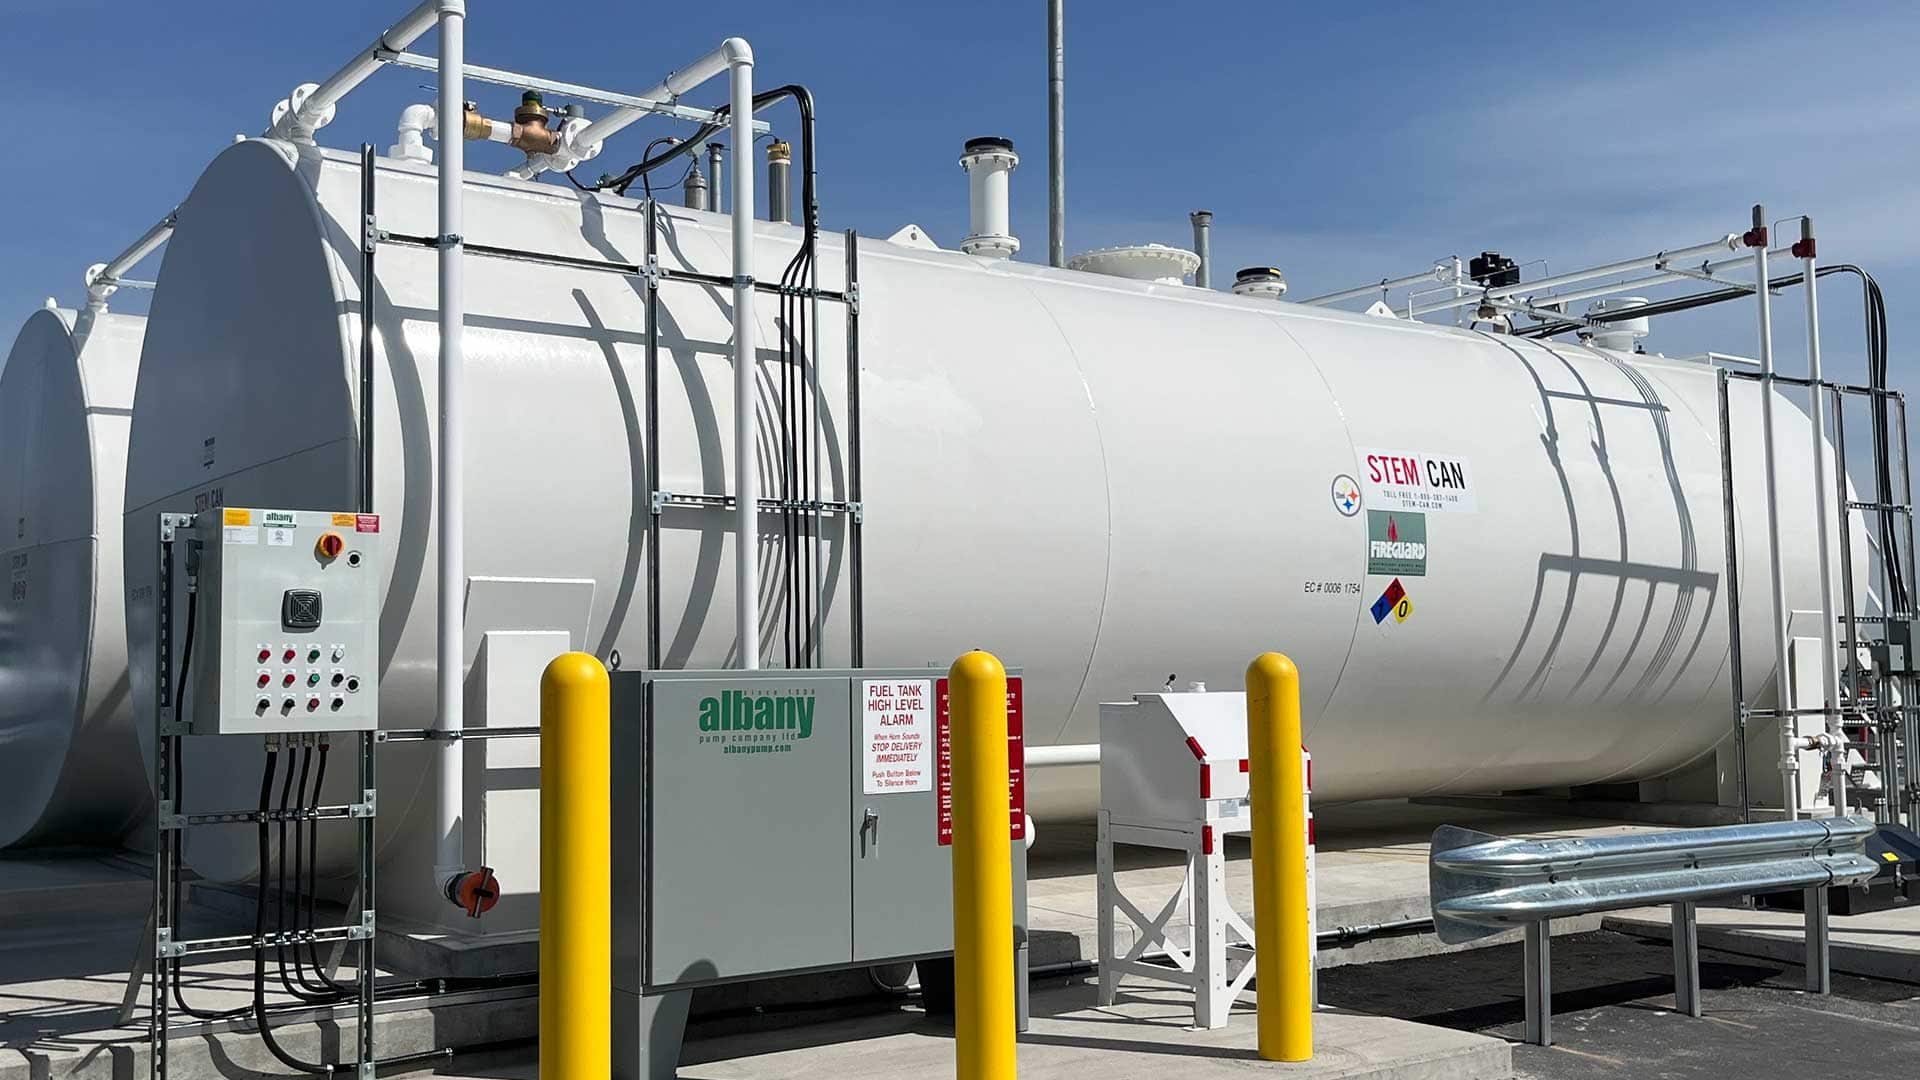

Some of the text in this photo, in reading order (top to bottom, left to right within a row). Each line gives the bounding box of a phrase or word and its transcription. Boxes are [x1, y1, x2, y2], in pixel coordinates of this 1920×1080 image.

[1367, 454, 1466, 490] STEM CAN
[1383, 490, 1397, 499] TOLL
[1398, 491, 1412, 499] FREE
[266, 512, 294, 523] albany
[1304, 581, 1361, 594] EC # 0006 1754
[1398, 600, 1408, 618] 0
[869, 684, 922, 697] FUEL TANK
[868, 698, 924, 711] HIGH LEVEL
[699, 689, 815, 739] albany
[880, 713, 914, 726] ALARM
[699, 735, 727, 744] pump
[732, 734, 777, 744] company
[874, 733, 888, 741] When
[902, 732, 920, 740] Sounds
[723, 744, 792, 754] albanypump.com
[871, 741, 923, 752] STOP DELIVERY
[876, 753, 918, 763] IMMEDIATELY
[872, 769, 921, 779] Push Button Below
[885, 779, 904, 787] Silence
